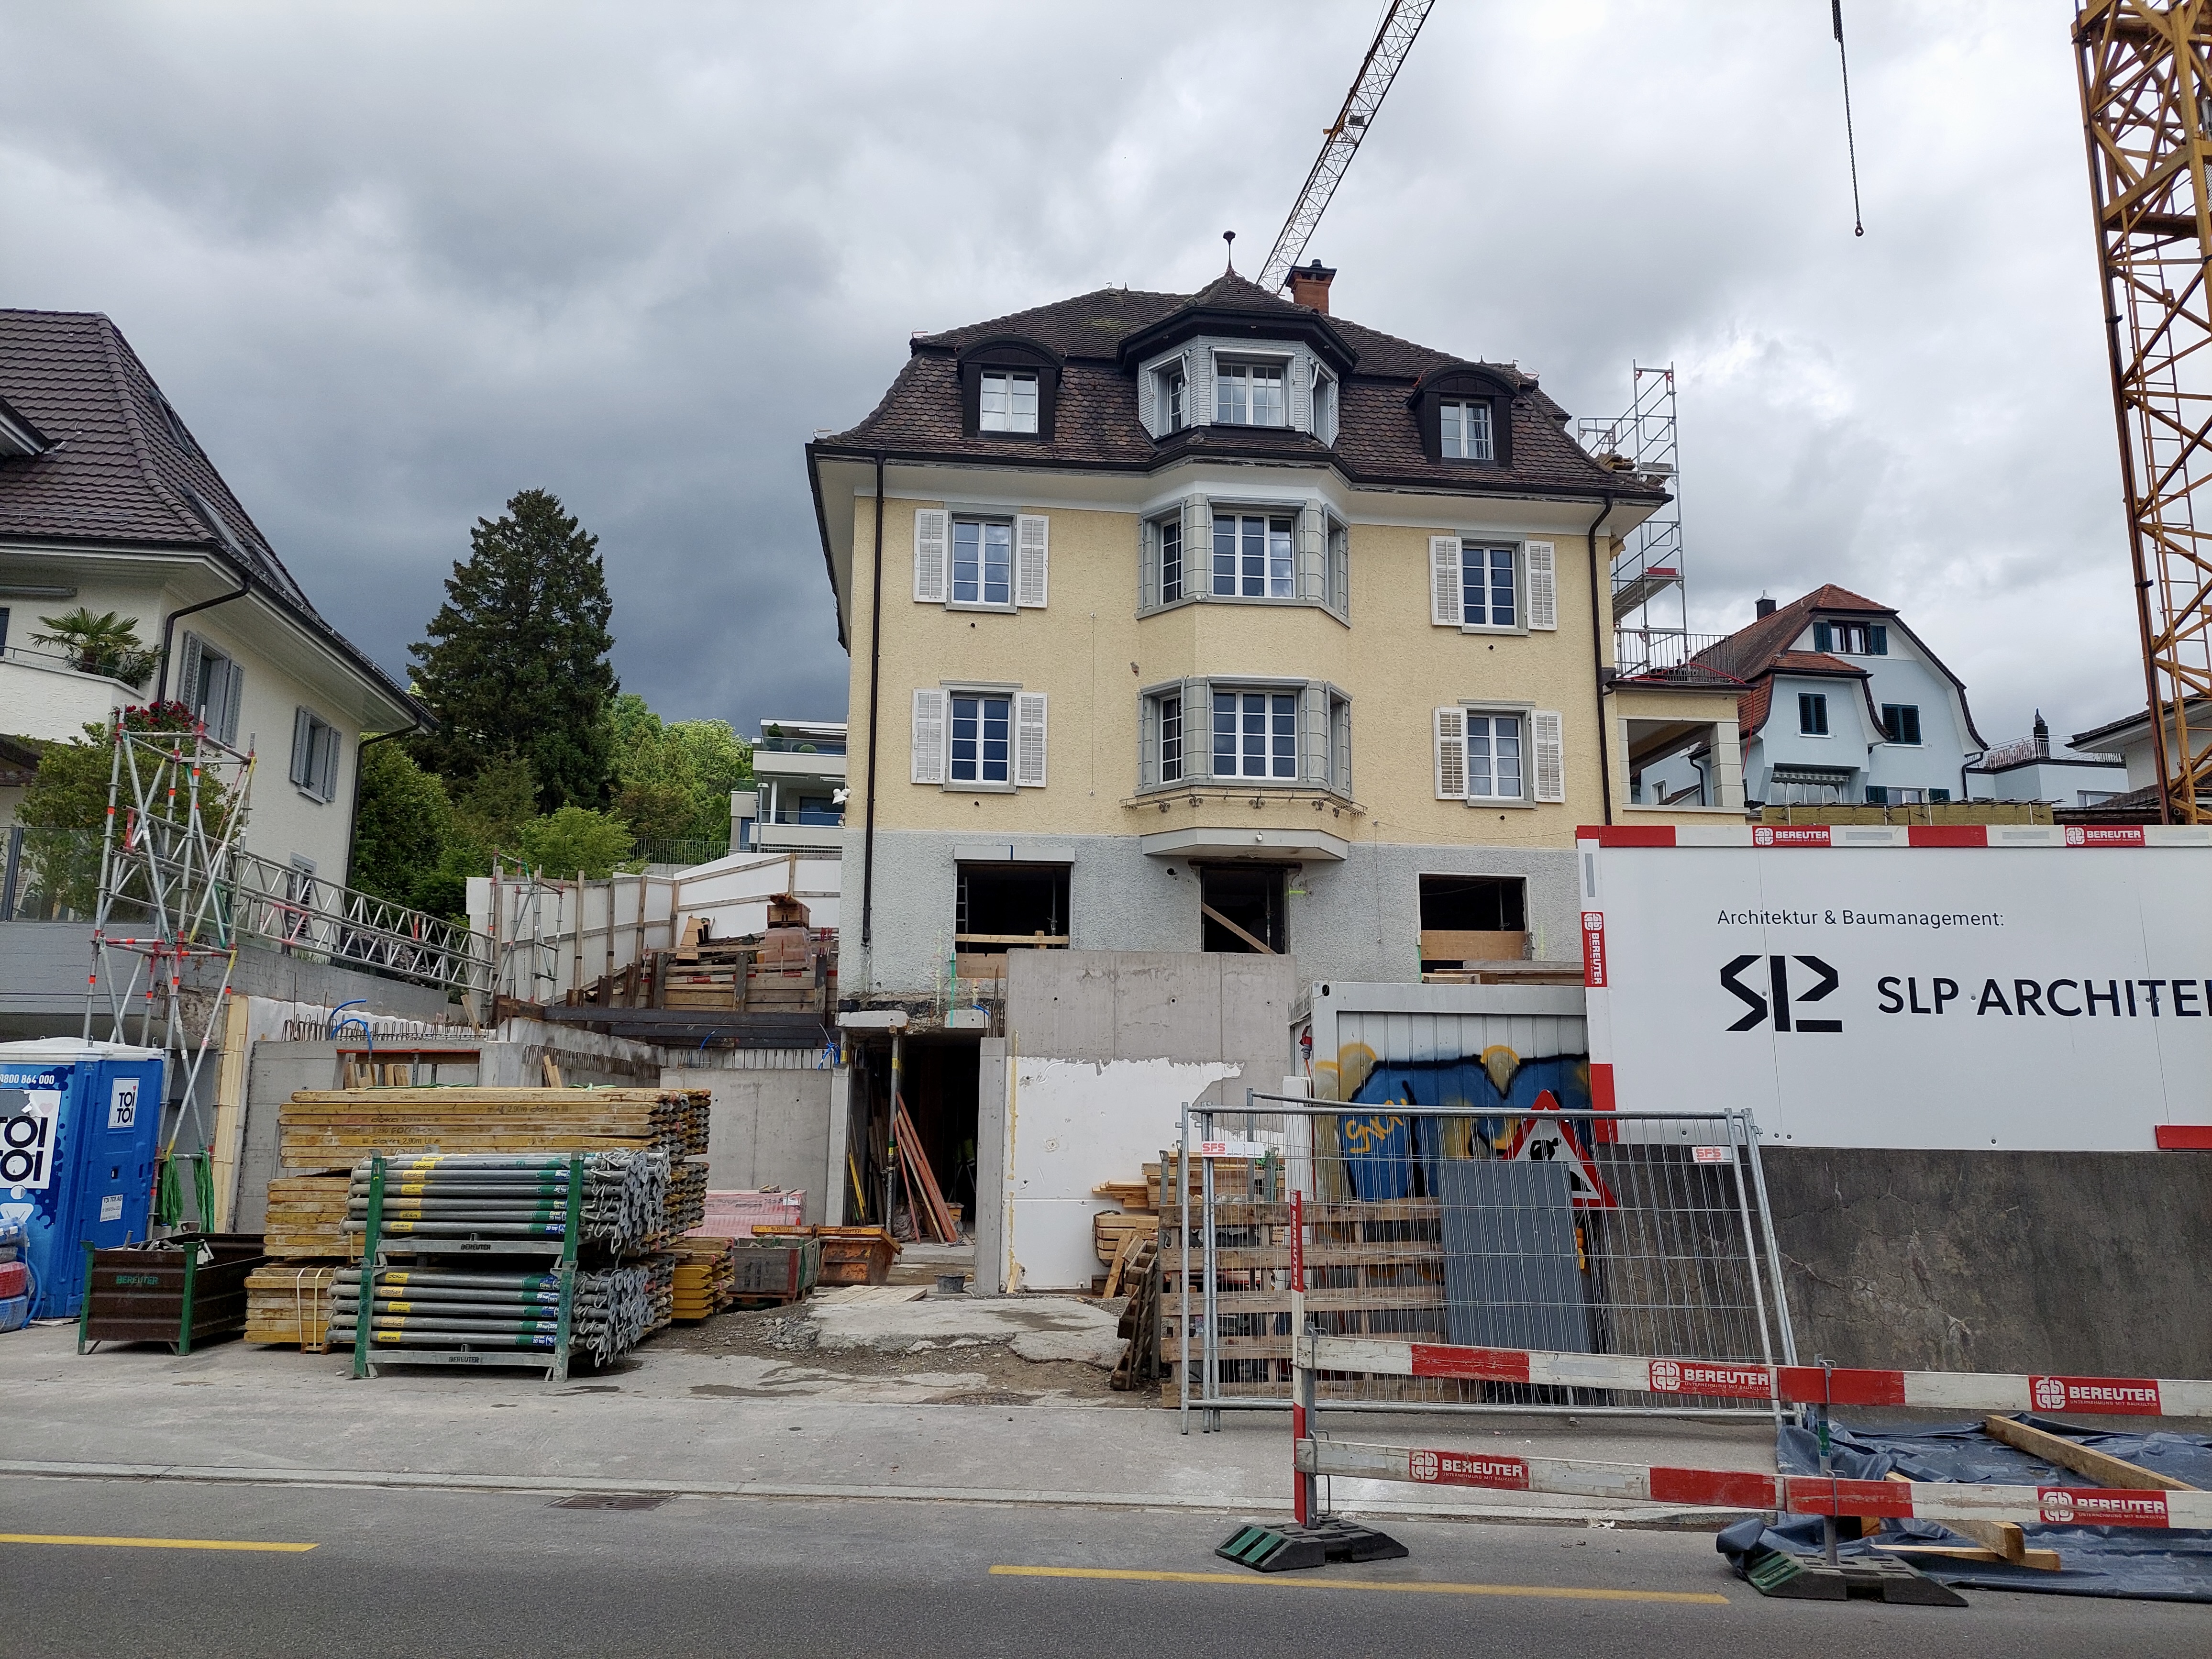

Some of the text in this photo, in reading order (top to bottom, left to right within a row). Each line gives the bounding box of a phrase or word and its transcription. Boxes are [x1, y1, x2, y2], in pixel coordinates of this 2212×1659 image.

[1717, 910, 2004, 929] Architektur & Baumanagement:
[1592, 933, 1602, 984] BEREUTER
[1877, 976, 1959, 1014] SLP
[21, 1074, 37, 1084] 864
[39, 1075, 55, 1084] 000
[119, 1092, 135, 1107] TOI
[117, 1107, 133, 1123] TOI
[0, 1116, 48, 1148] OI
[1202, 1143, 1226, 1152] SFS
[1696, 1148, 1721, 1157] SFS
[0, 1149, 44, 1182] OI
[1684, 1369, 1769, 1386] BEREUTER
[2069, 1386, 2157, 1401] BEREUTER
[1442, 1459, 1523, 1477] BEREUTER
[1442, 1471, 1482, 1480] UNTERNEHMUNG
